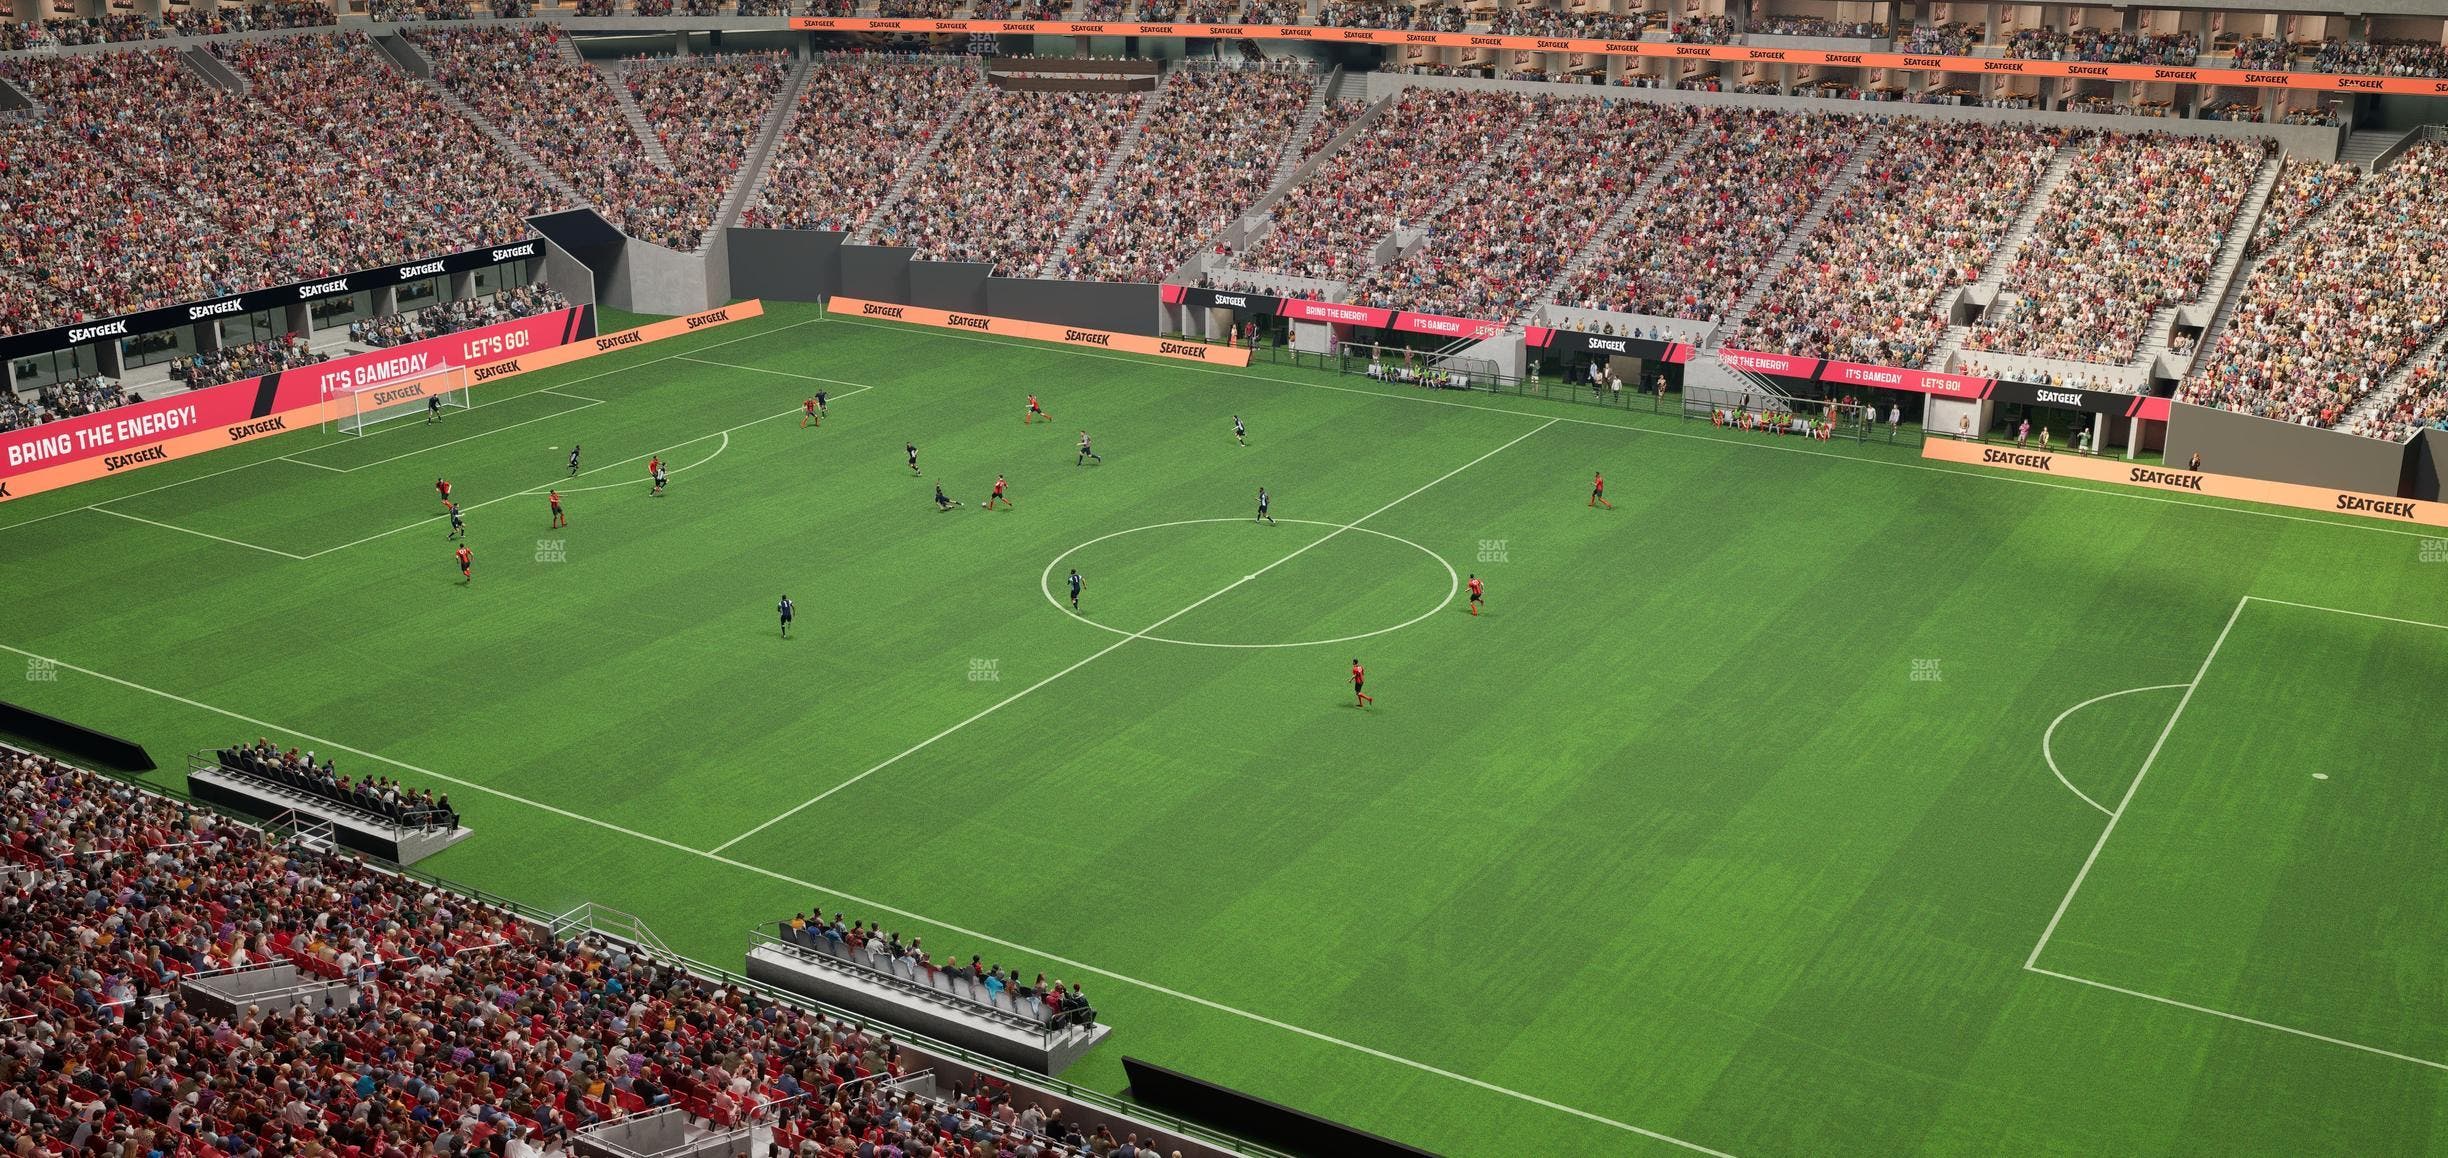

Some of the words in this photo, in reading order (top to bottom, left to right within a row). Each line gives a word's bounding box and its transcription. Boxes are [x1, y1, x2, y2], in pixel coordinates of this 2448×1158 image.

[803, 19, 835, 28] SEATGEEK
[869, 21, 901, 29] SEATGEEK
[935, 22, 968, 30] SEATGEEK
[1002, 23, 1035, 31] SEATGEEK
[1071, 24, 1104, 33] SEATGEEK
[1140, 25, 1173, 34] SEATGEEK
[1209, 27, 1243, 35] SEATGEEK
[1280, 28, 1312, 37] SEATGEEK
[1343, 31, 1374, 40] SEATGEEK
[1406, 34, 1437, 43] SEATGEEK
[1470, 37, 1502, 46] SEATGEEK
[1537, 40, 1569, 49] SEATGEEK
[1605, 43, 1639, 53] SEATGEEK
[1676, 46, 1711, 57] SEATGEEK
[1749, 50, 1785, 60] SEATGEEK
[1825, 53, 1862, 64] SEATGEEK
[1903, 57, 1941, 68] SEATGEEK
[1984, 61, 2024, 72] SEATGEEK
[2068, 65, 2109, 76] SEATGEEK
[2154, 69, 2197, 80] SEATGEEK
[2244, 73, 2289, 85] SEATGEEK
[492, 243, 534, 262] SEATGEEK
[400, 260, 445, 279] SEATGEEK
[299, 278, 348, 298] SEATGEEK
[1214, 294, 1246, 308] SEATGEEK
[189, 298, 243, 320] SEATGEEK
[862, 303, 904, 319] SEATGEEK
[1305, 306, 1326, 317] BRING
[1327, 308, 1339, 319] THE
[1340, 310, 1368, 322] ENERGY!
[686, 309, 730, 330] SEATGEEK
[947, 314, 991, 331] SEATGEEK
[1413, 318, 1427, 329] IT'S
[1428, 320, 1460, 333] GAMEDAY
[68, 320, 128, 343] SEATGEEK
[1064, 329, 1111, 347] SEATGEEK
[463, 335, 502, 360] LET'S
[505, 329, 529, 350] GO!
[596, 330, 643, 352] SEATGEEK
[1588, 337, 1626, 353] SEATGEEK
[1159, 341, 1207, 359] SEATGEEK
[473, 359, 522, 382] SEATGEEK
[1739, 356, 1755, 367] THE
[1755, 359, 1789, 371] ENERGY!
[321, 370, 352, 394] IT'S
[355, 352, 428, 385] GAMEDAY
[1845, 368, 1862, 380] IT'S
[1862, 370, 1903, 384] GAMEDAY
[1920, 377, 1944, 390] LET'S
[1945, 380, 1961, 392] GO!
[373, 382, 425, 406] SEATGEEK
[2036, 388, 2082, 407] SEATGEEK
[8, 433, 72, 467] BRING
[75, 424, 115, 450] THE
[117, 404, 197, 441] ENERGY!
[228, 415, 287, 441] SEATGEEK
[103, 444, 168, 472] SEATGEEK
[1982, 448, 2052, 471] SEATGEEK
[2129, 467, 2203, 491] SEATGEEK
[2336, 494, 2416, 519] SEATGEEK
